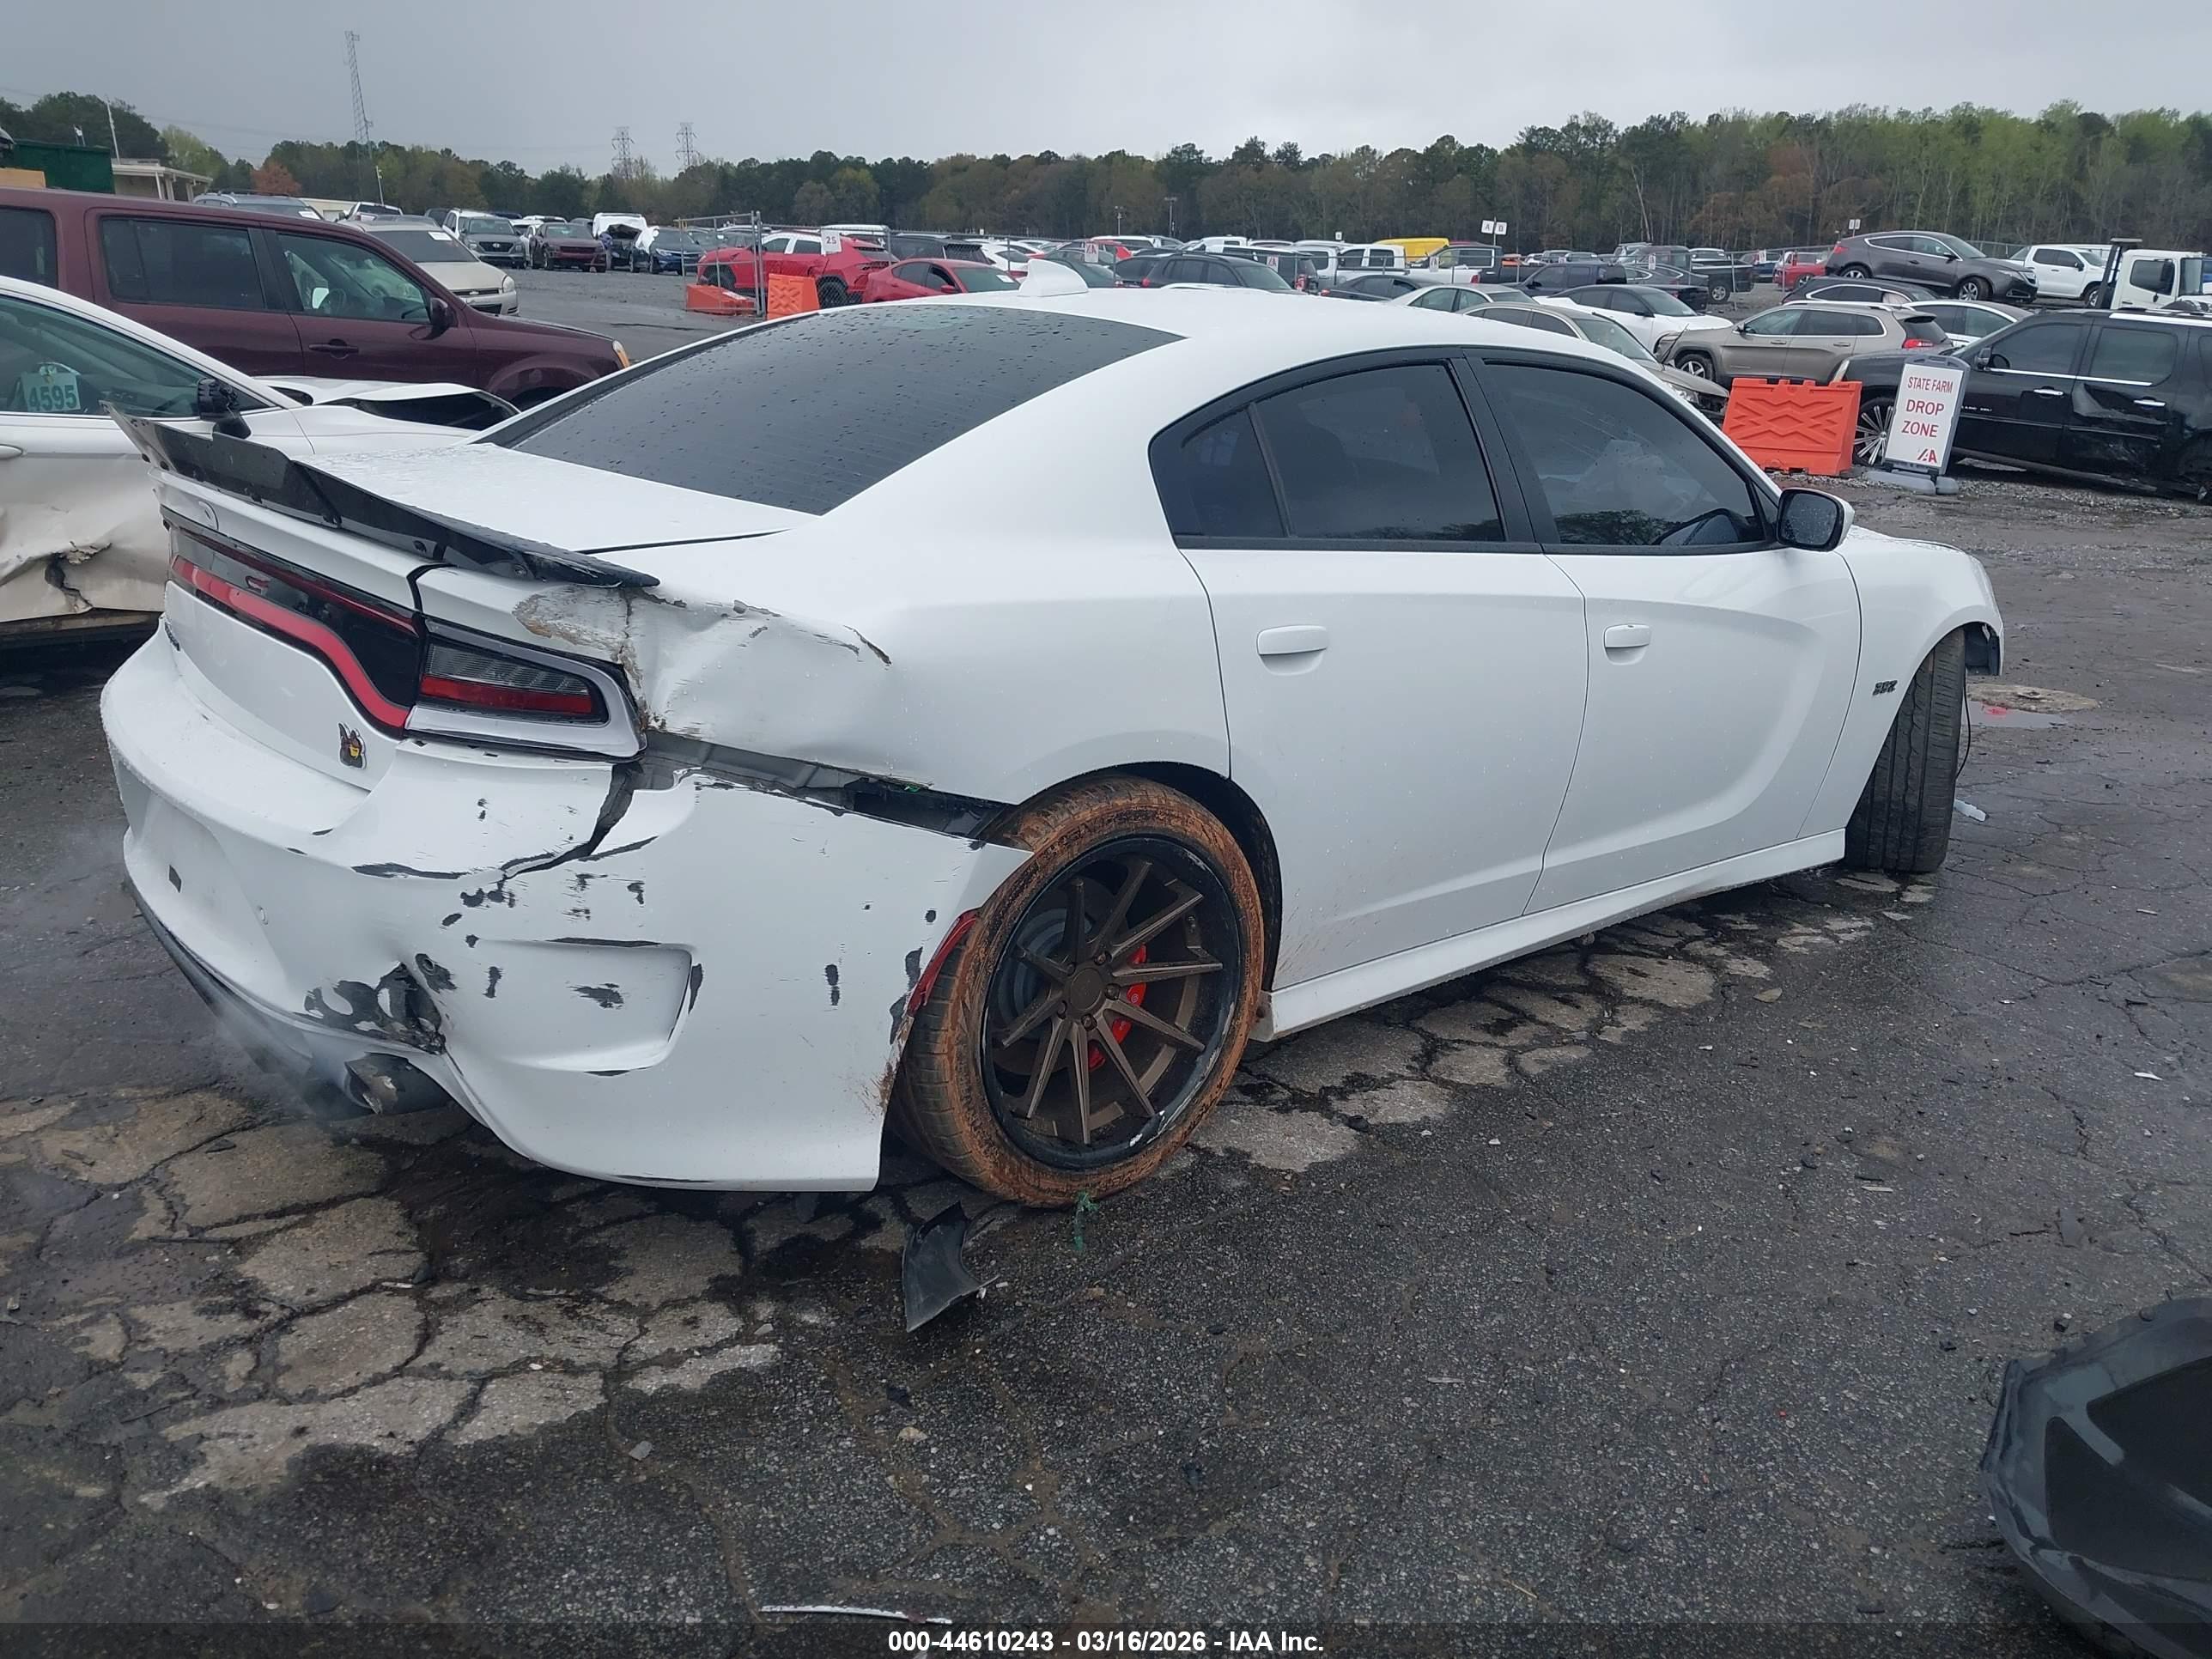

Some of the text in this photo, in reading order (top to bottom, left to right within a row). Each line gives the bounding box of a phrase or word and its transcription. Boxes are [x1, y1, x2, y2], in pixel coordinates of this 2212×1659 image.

[1907, 376, 1953, 394] STATE FARM
[28, 384, 76, 411] 4595
[1905, 399, 1944, 416] DROP
[1901, 420, 1939, 438] ZONE
